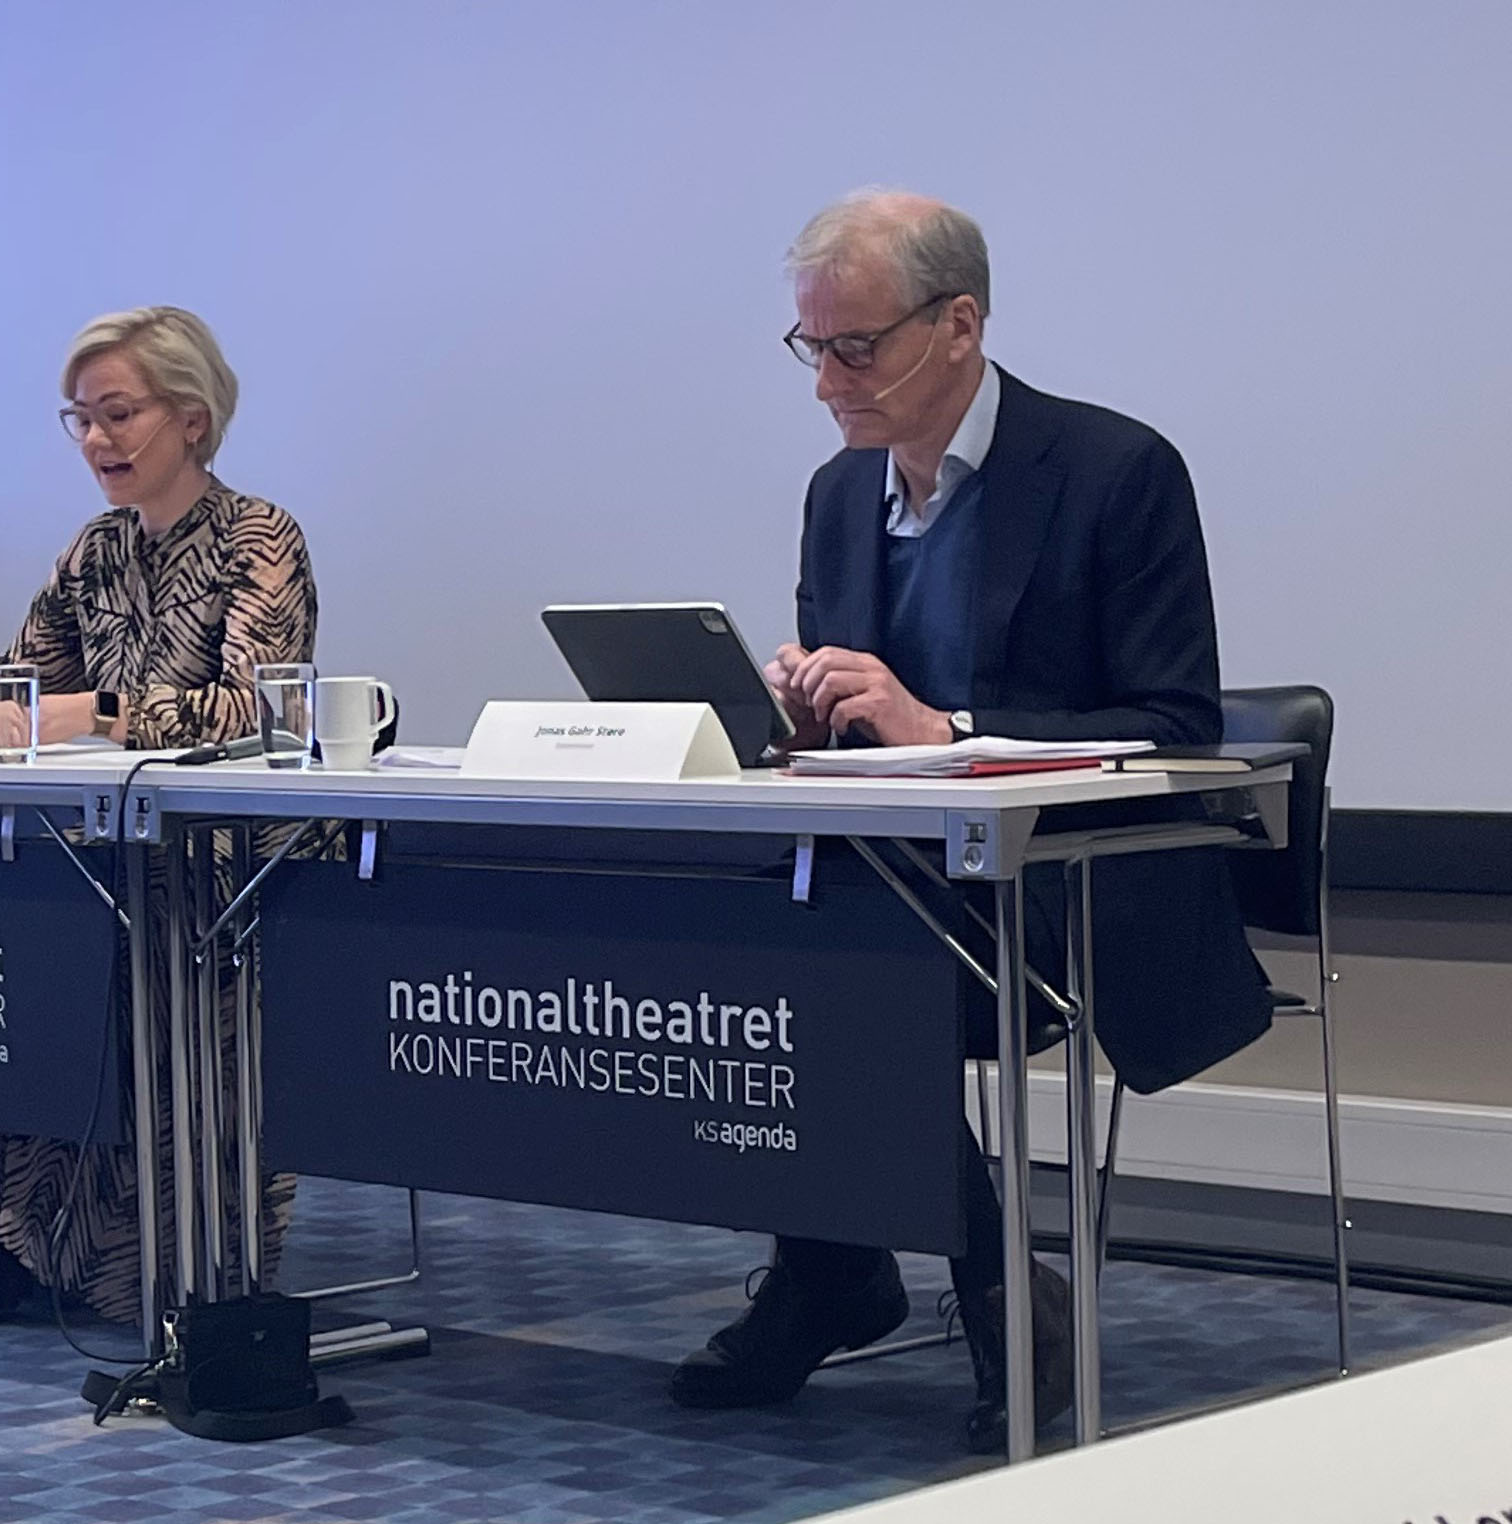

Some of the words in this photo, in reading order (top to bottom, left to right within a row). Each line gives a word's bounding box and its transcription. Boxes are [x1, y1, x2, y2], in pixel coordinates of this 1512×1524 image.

[534, 725, 565, 738] Jonas
[567, 724, 595, 737] Gahr
[389, 970, 794, 1053] nationaltheatret
[389, 1032, 796, 1110] KONFERANSESENTER
